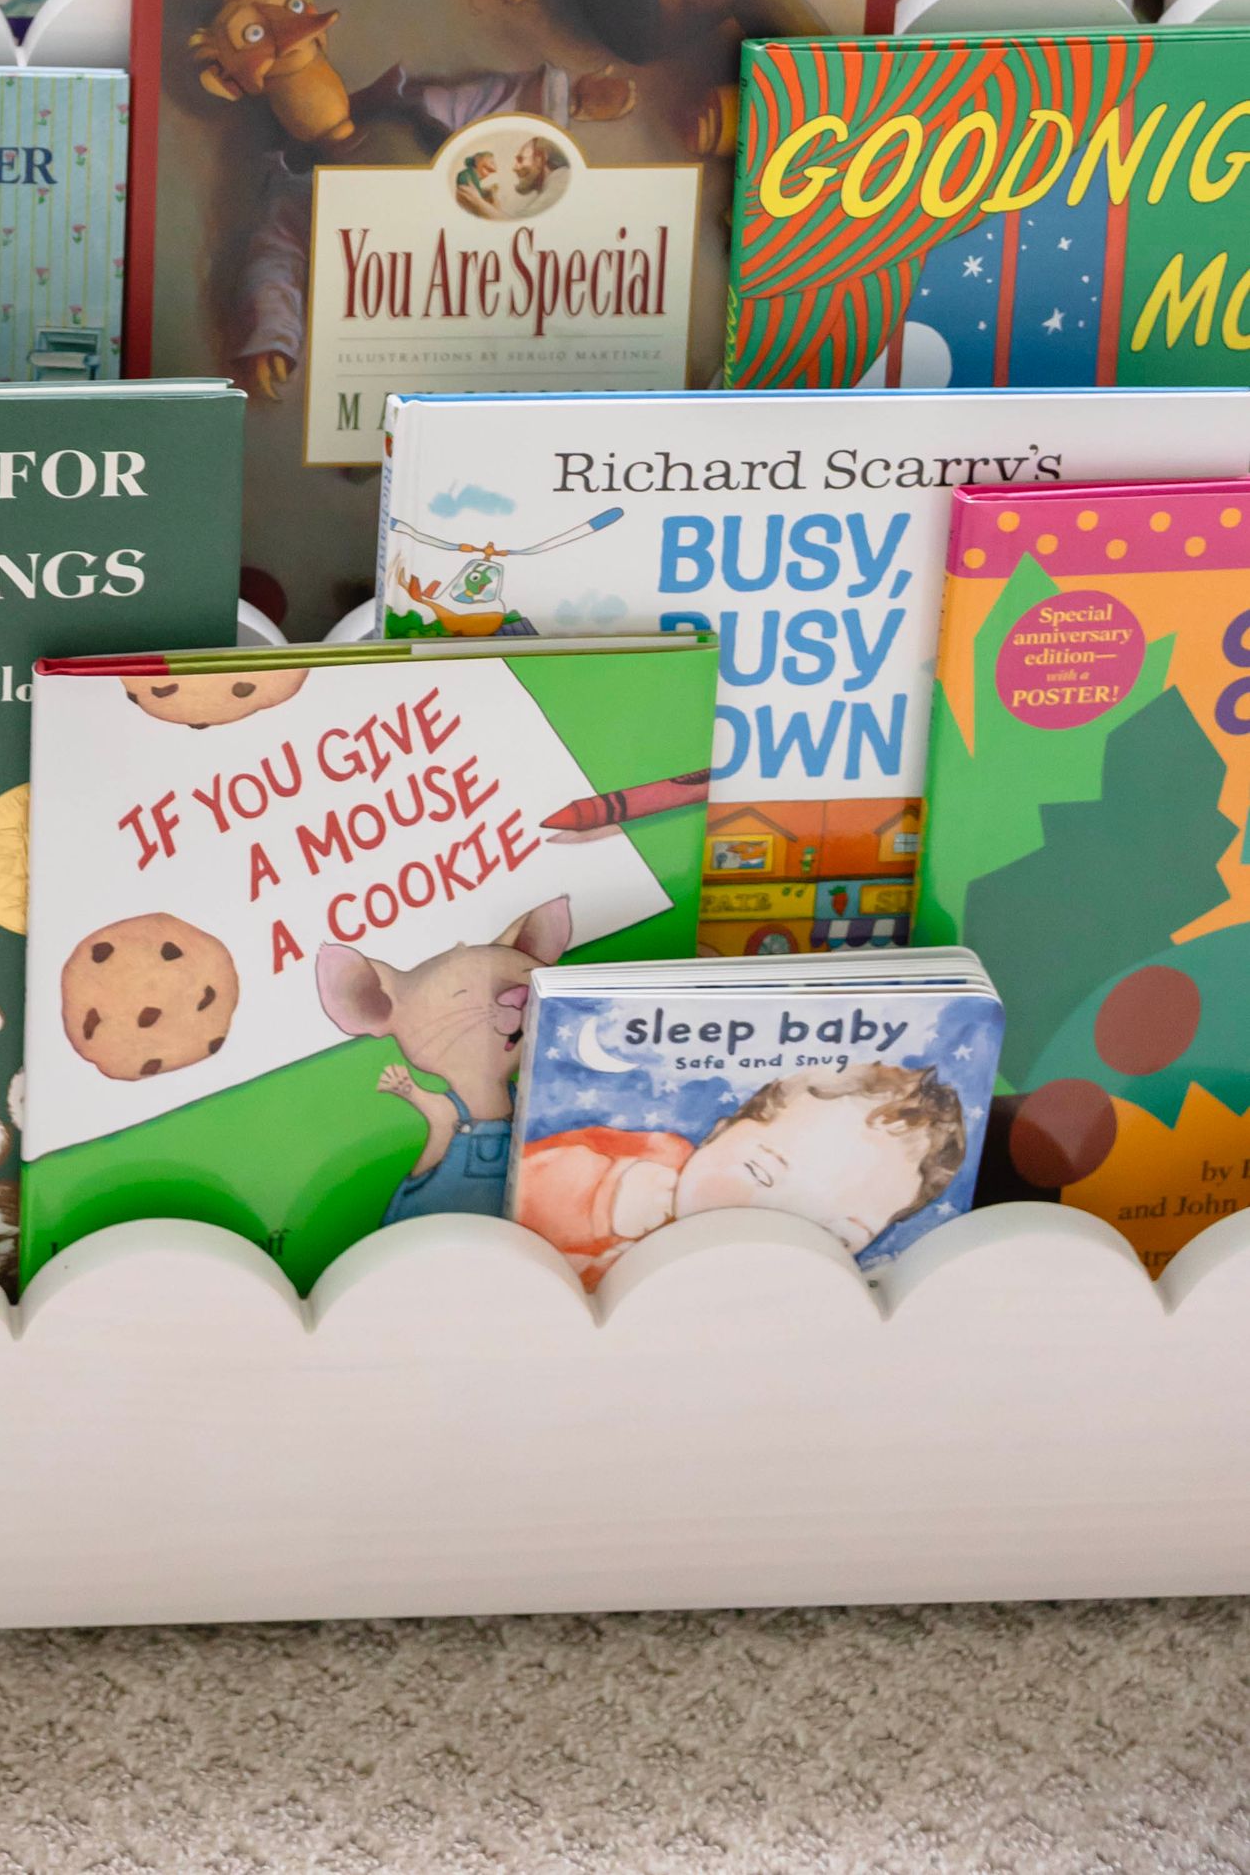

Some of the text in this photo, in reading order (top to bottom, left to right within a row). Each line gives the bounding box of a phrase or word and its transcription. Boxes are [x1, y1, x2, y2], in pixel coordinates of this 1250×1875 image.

[336, 227, 414, 320] You
[422, 227, 501, 319] Are
[508, 225, 669, 337] Special
[336, 349, 663, 364] ILLUSTRATIONS BY SERGIO MARTINEZ
[551, 443, 1063, 494] Richard Scarry's
[657, 512, 913, 599] BUSY,
[1037, 603, 1113, 627] Special
[660, 607, 907, 692] USY
[1012, 628, 1133, 650] anniversary
[1046, 670, 1090, 683] with a
[1011, 685, 1120, 708] POSTER!
[117, 687, 462, 871] IF YOU GIVE
[249, 755, 501, 902] A MOUSE
[271, 808, 543, 974] A COOKIE
[625, 1007, 909, 1056] sleep baby
[738, 1053, 782, 1068] and
[1201, 1160, 1233, 1186] by
[1117, 1193, 1238, 1221] and John
